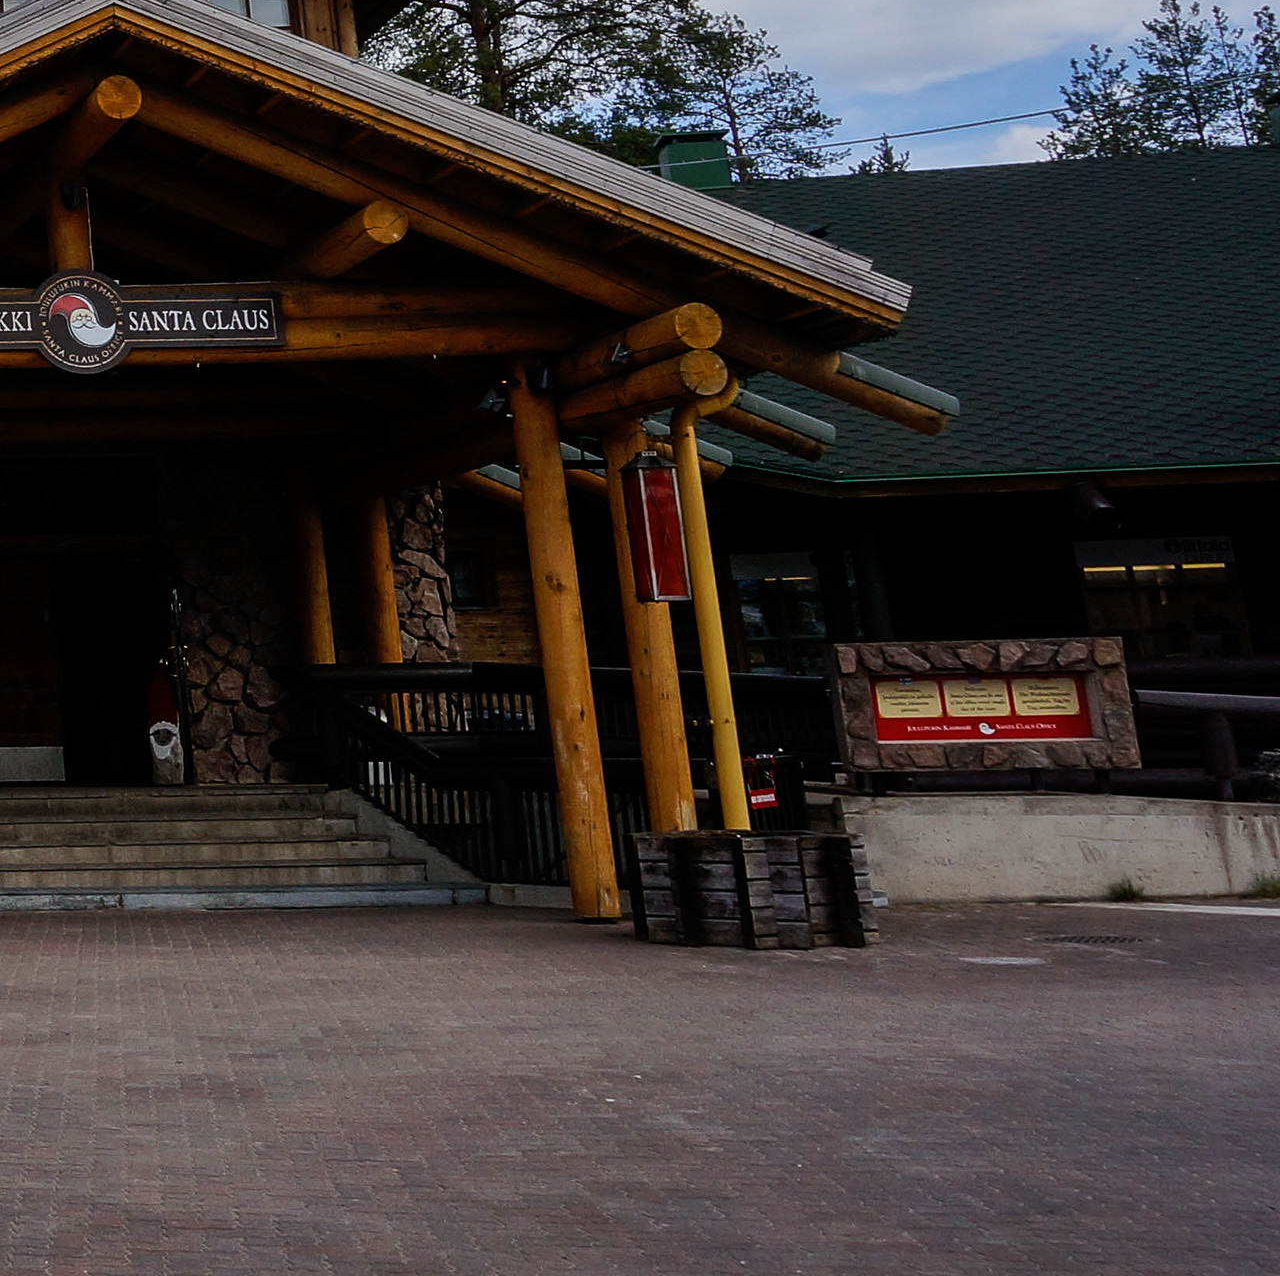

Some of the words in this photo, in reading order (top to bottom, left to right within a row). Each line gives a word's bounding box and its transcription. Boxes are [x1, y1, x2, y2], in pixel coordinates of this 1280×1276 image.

[39, 280, 80, 317] JOULUPUKIN
[83, 280, 123, 316] KAMMARI
[128, 309, 197, 332] SANTA
[201, 308, 270, 331] CLAUS
[42, 329, 65, 357] SANTA
[68, 353, 100, 363] CLAUS
[101, 330, 124, 357] OFFICE
